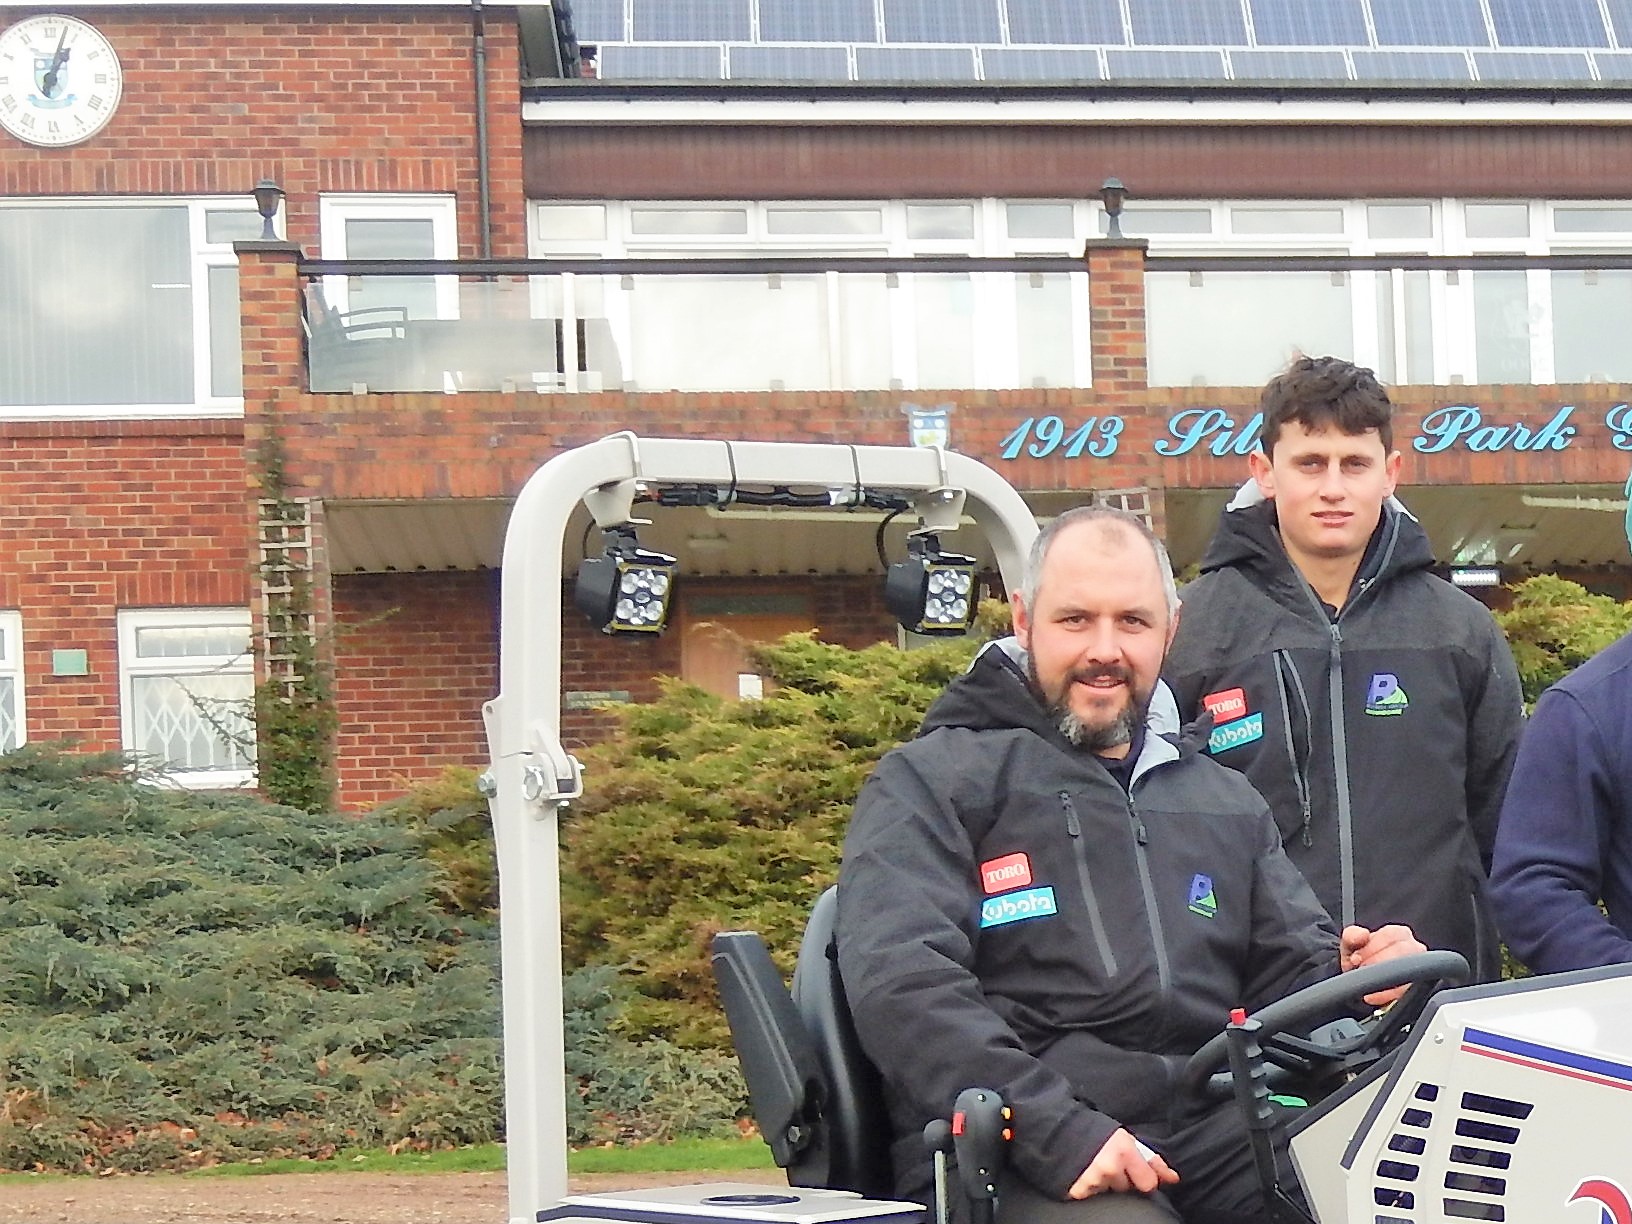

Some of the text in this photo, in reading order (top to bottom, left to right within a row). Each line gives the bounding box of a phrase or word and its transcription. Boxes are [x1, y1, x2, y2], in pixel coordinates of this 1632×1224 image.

[999, 415, 1125, 459] 1913
[1413, 406, 1576, 453] Park
[986, 862, 1026, 884] TORO
[981, 894, 1052, 921] Kubota
